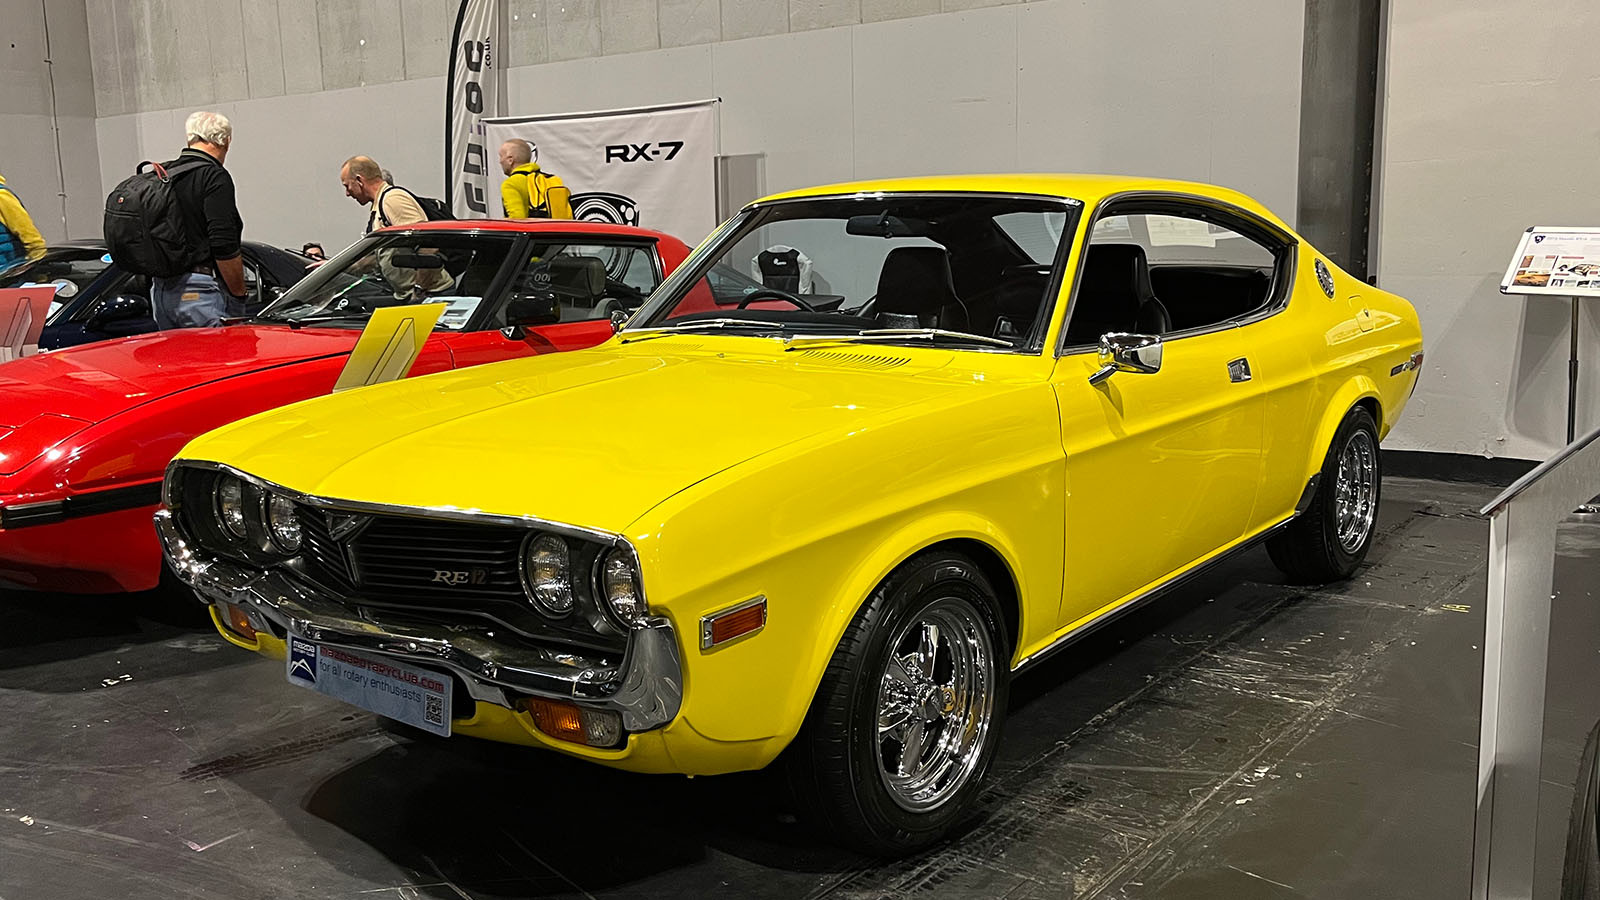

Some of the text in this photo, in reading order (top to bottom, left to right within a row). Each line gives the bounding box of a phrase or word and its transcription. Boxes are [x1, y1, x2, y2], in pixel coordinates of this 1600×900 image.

[605, 141, 684, 163] RX-7
[319, 658, 422, 703] for all rotary enthusiasts
